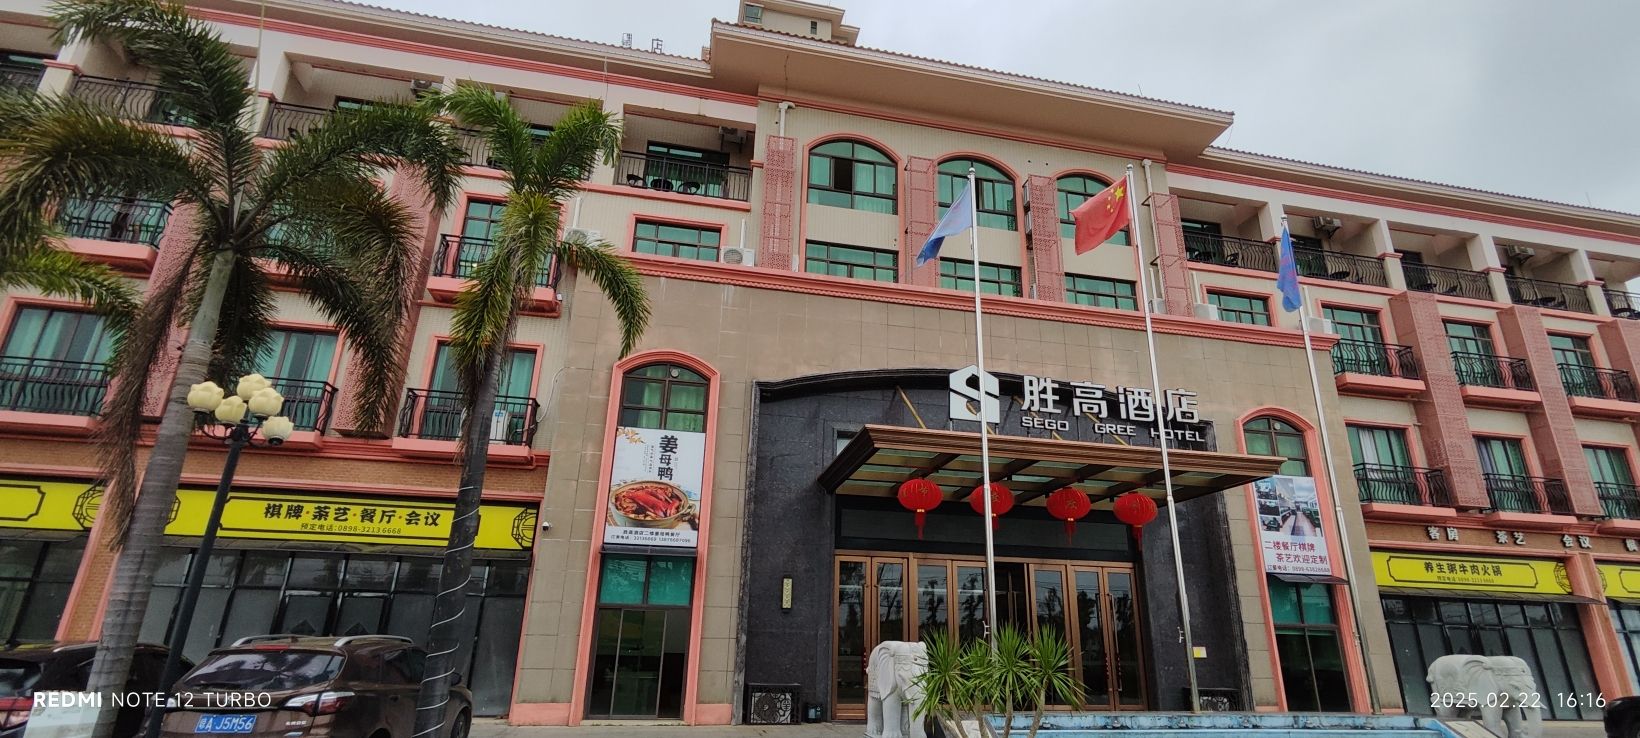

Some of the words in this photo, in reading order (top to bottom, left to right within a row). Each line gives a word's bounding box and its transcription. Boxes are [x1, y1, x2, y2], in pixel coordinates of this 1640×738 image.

[1020, 375, 1200, 423] 胜高酒店
[1021, 416, 1069, 431] SEGO
[1095, 423, 1136, 436] GREE
[1150, 427, 1205, 442] HOTEL
[657, 435, 679, 481] 姜母鸭
[1264, 540, 1316, 553] 二楼餐厅棋牌
[1427, 526, 1460, 541] 客房
[1496, 530, 1526, 545] 茶艺
[1562, 534, 1593, 549] 会议
[1275, 552, 1328, 565] 茶艺欢迎定制
